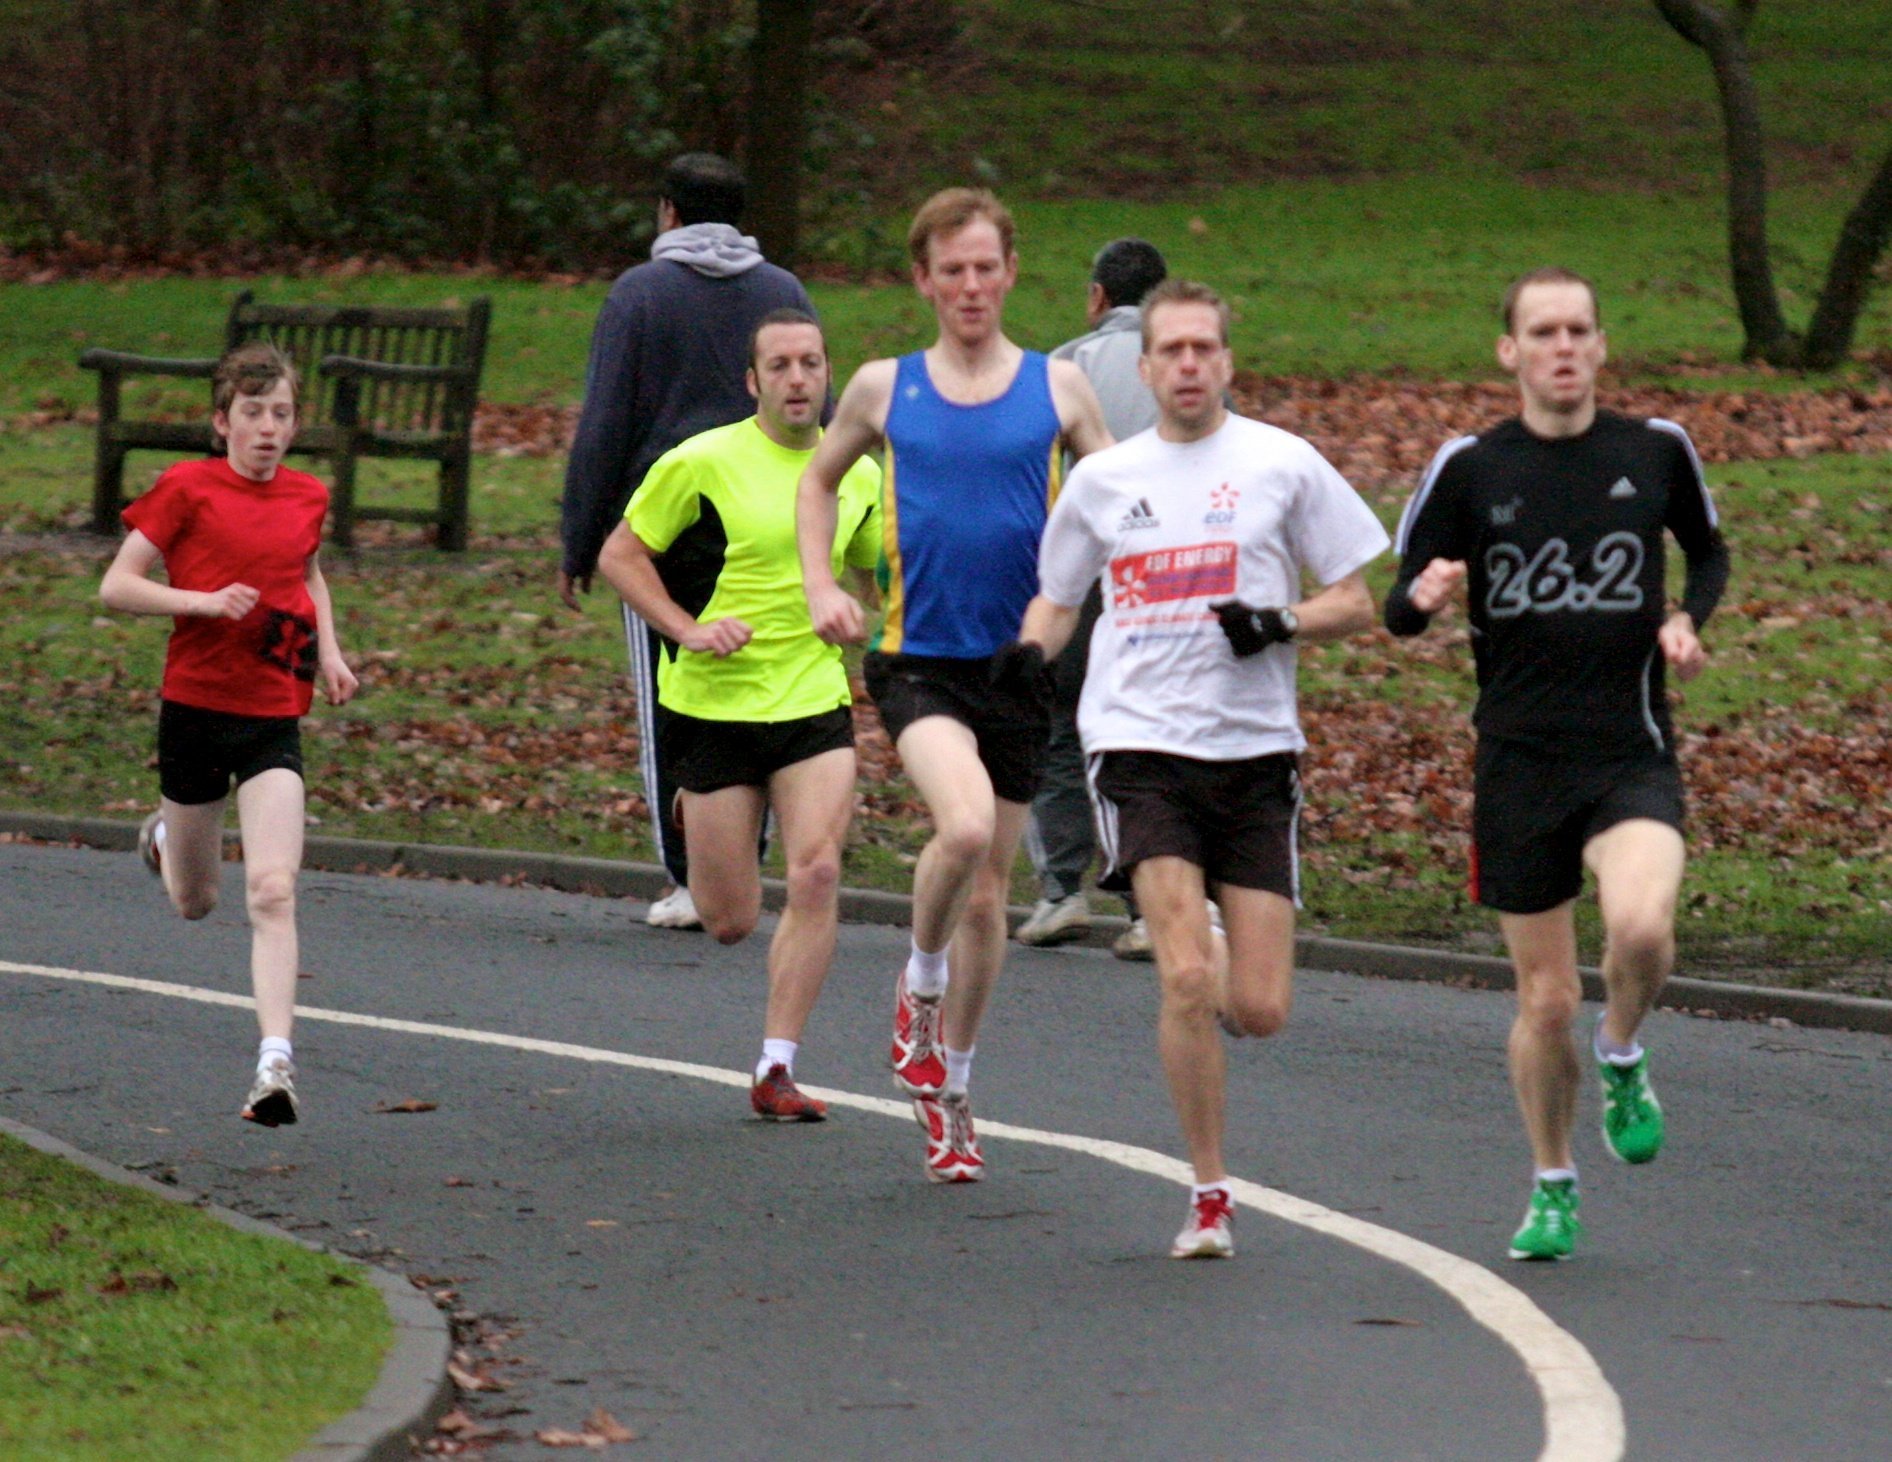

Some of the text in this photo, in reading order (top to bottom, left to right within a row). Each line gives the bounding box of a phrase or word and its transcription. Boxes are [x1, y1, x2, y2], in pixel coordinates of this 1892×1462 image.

[1145, 546, 1233, 572] EDF ENERGY
[1484, 531, 1645, 619] 26.2
